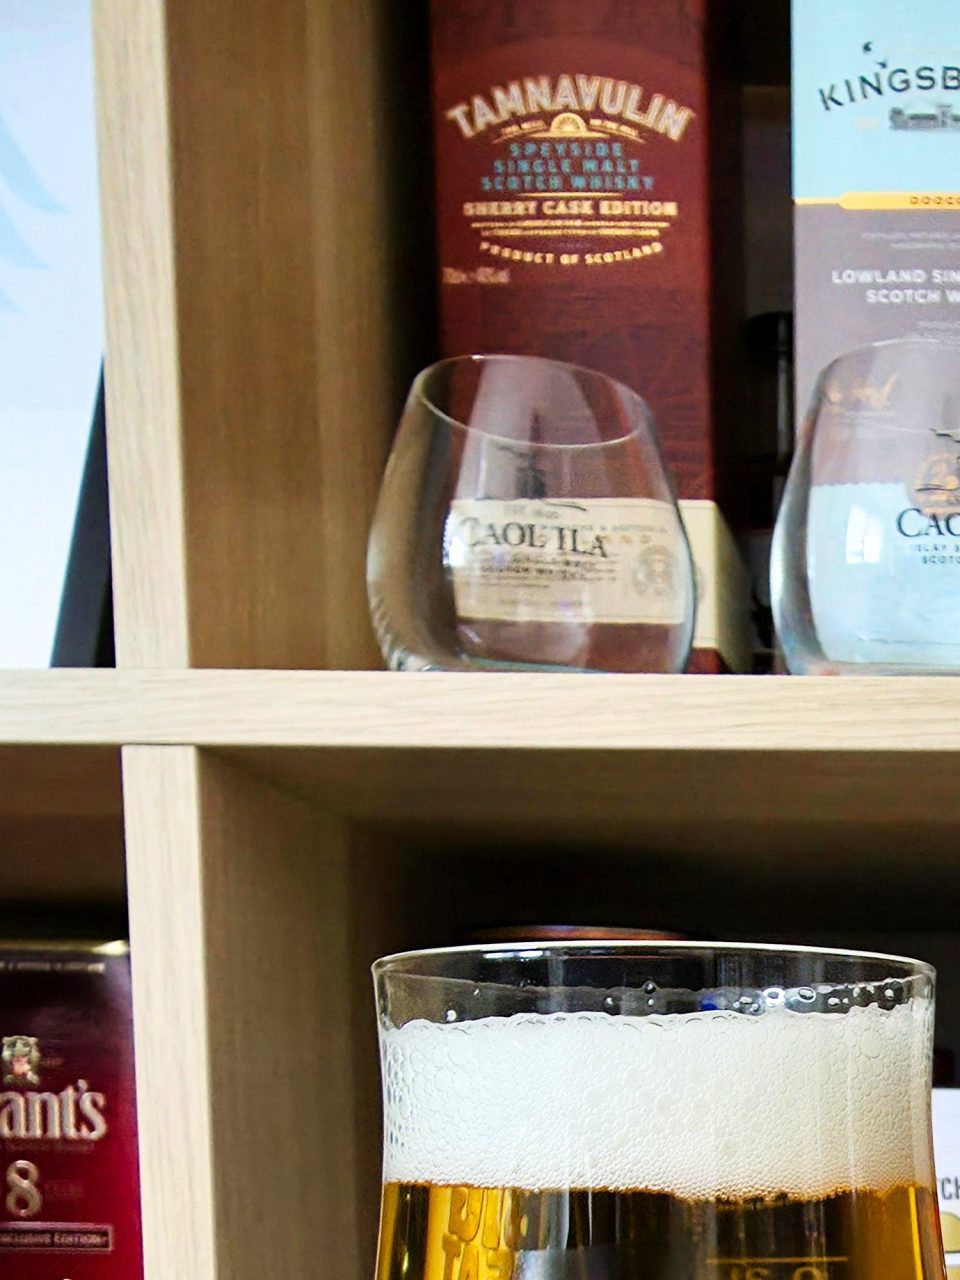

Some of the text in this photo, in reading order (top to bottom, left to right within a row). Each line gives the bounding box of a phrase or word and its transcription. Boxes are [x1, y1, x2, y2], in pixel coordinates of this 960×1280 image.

[447, 74, 695, 141] TAMNAVULIN
[582, 159, 639, 173] MALT
[542, 201, 593, 215] CASK
[600, 201, 678, 216] EDITION
[832, 269, 925, 284] LOWLAND
[866, 289, 940, 304] SCOTCH
[6, 1160, 42, 1217] 8
